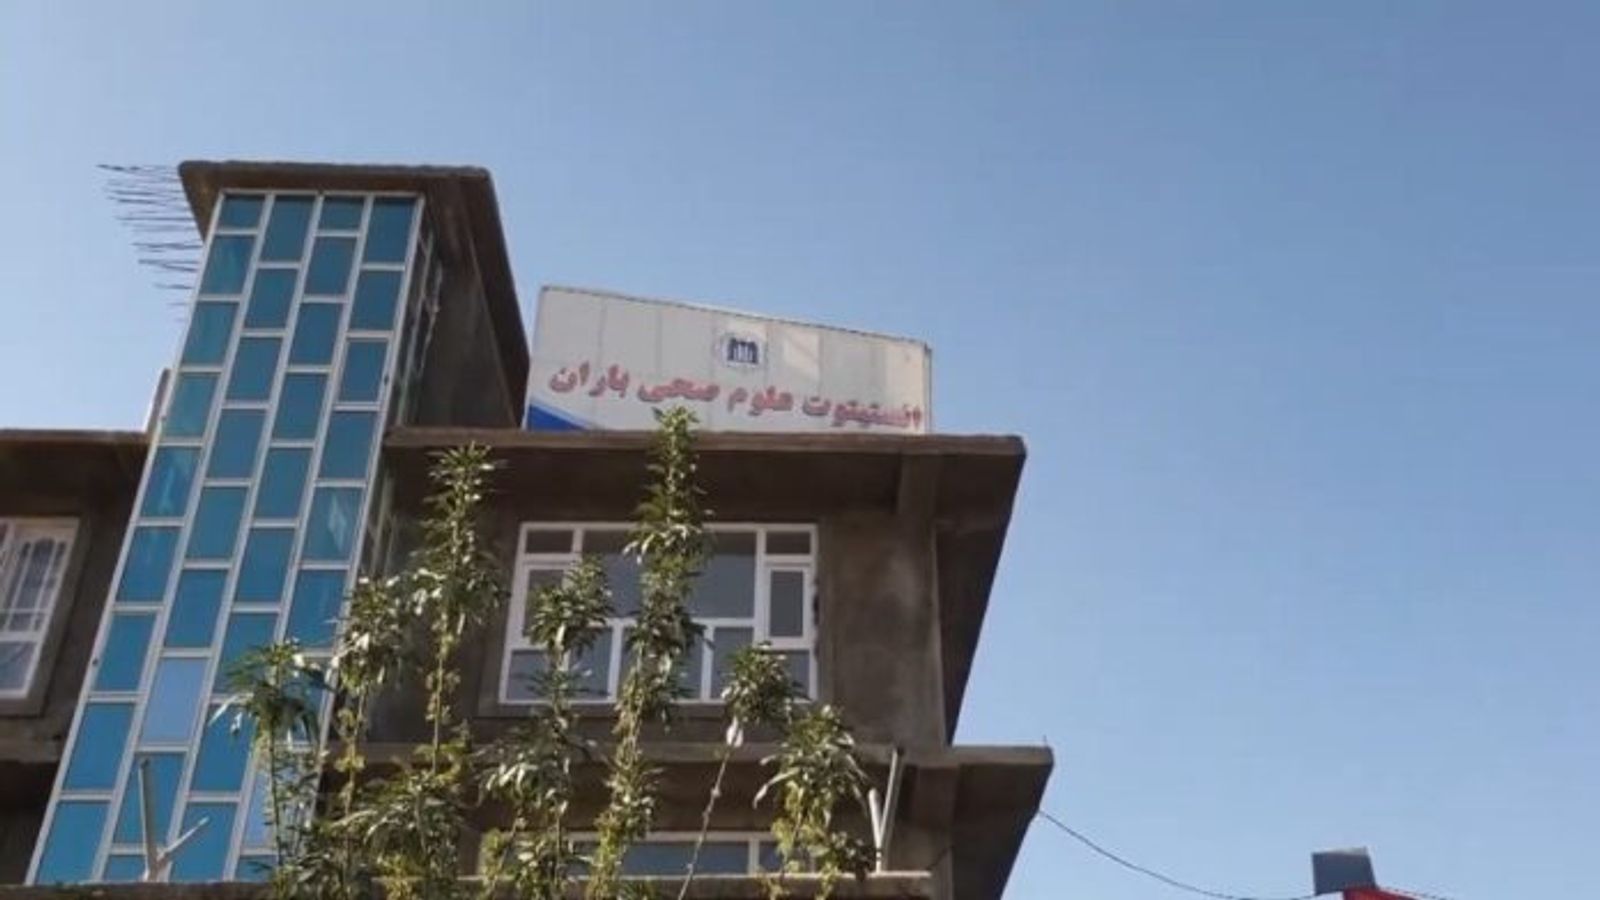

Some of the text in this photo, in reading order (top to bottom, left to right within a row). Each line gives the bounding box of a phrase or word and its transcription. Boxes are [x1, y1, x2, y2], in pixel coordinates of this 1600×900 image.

[548, 361, 630, 399] باران
[637, 378, 721, 403] صحی
[726, 386, 794, 416] علوم
